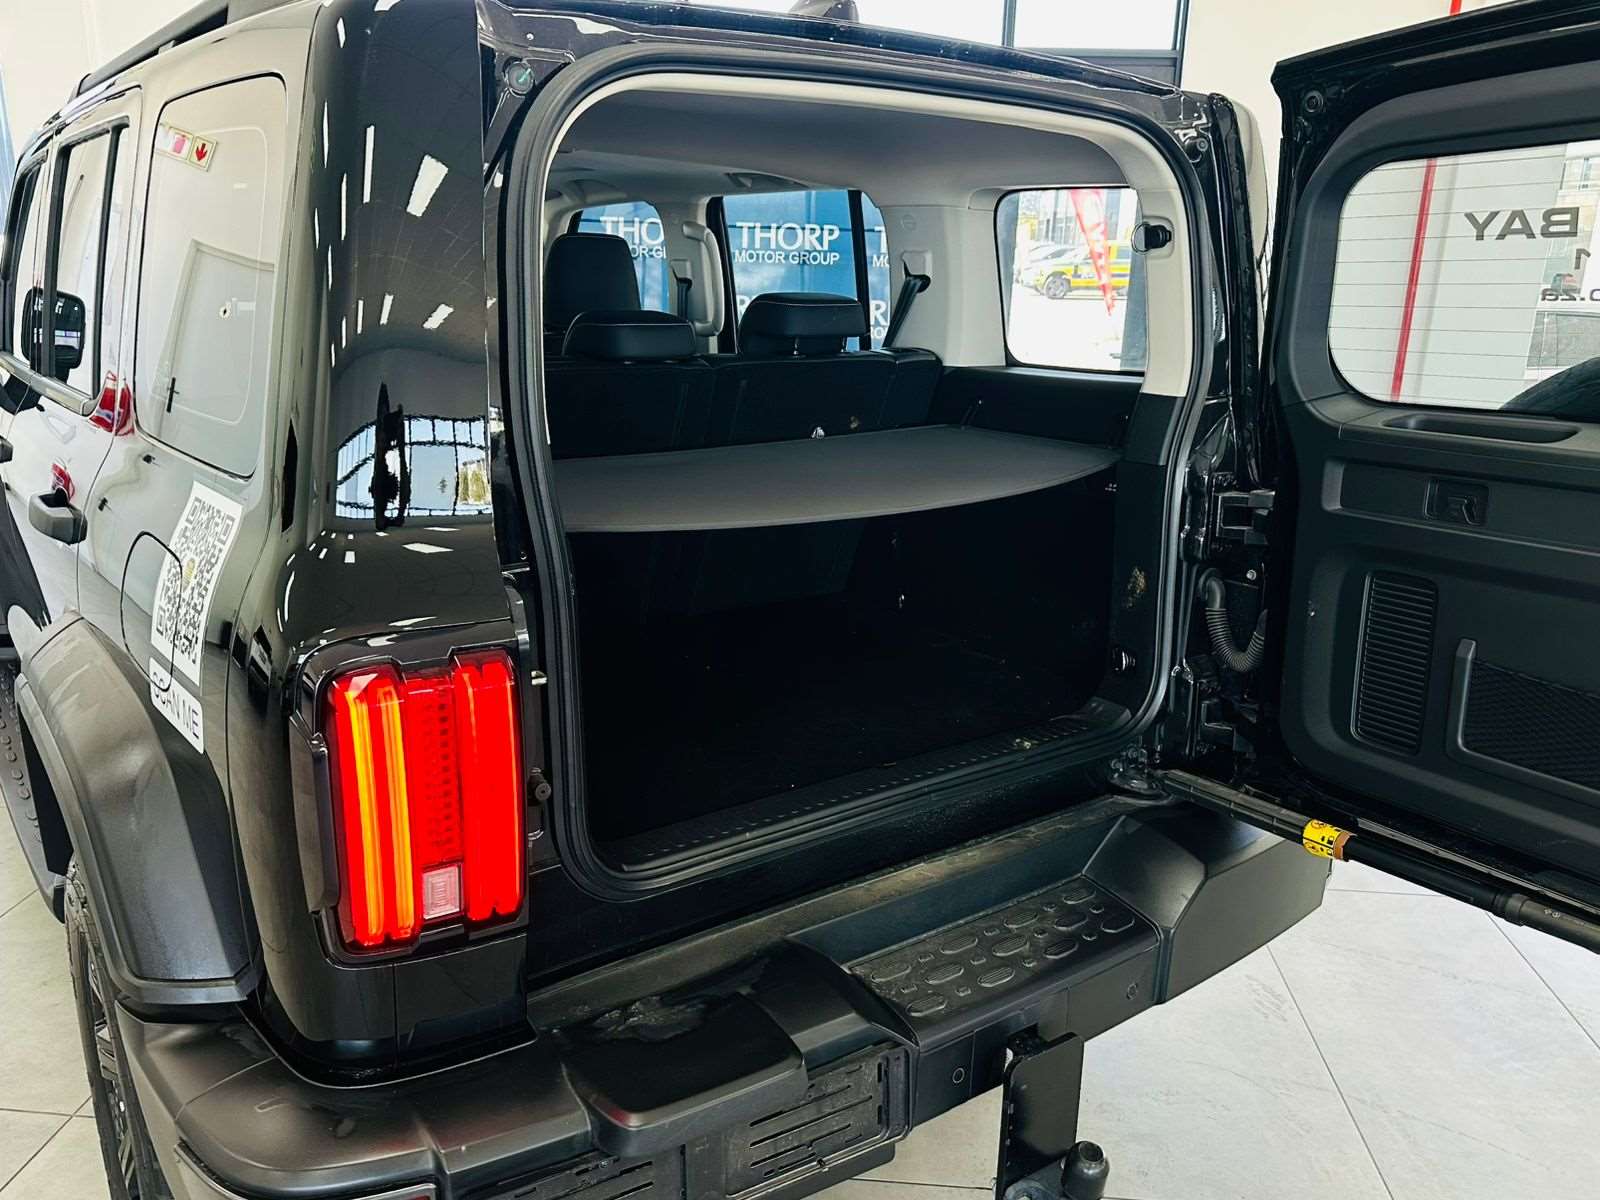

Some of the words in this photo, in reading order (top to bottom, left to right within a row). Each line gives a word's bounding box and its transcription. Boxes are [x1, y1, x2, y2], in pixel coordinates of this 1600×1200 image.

[736, 222, 840, 250] THORP
[735, 250, 785, 264] MOTOR
[789, 252, 840, 265] GROUP
[182, 699, 200, 740] ME
